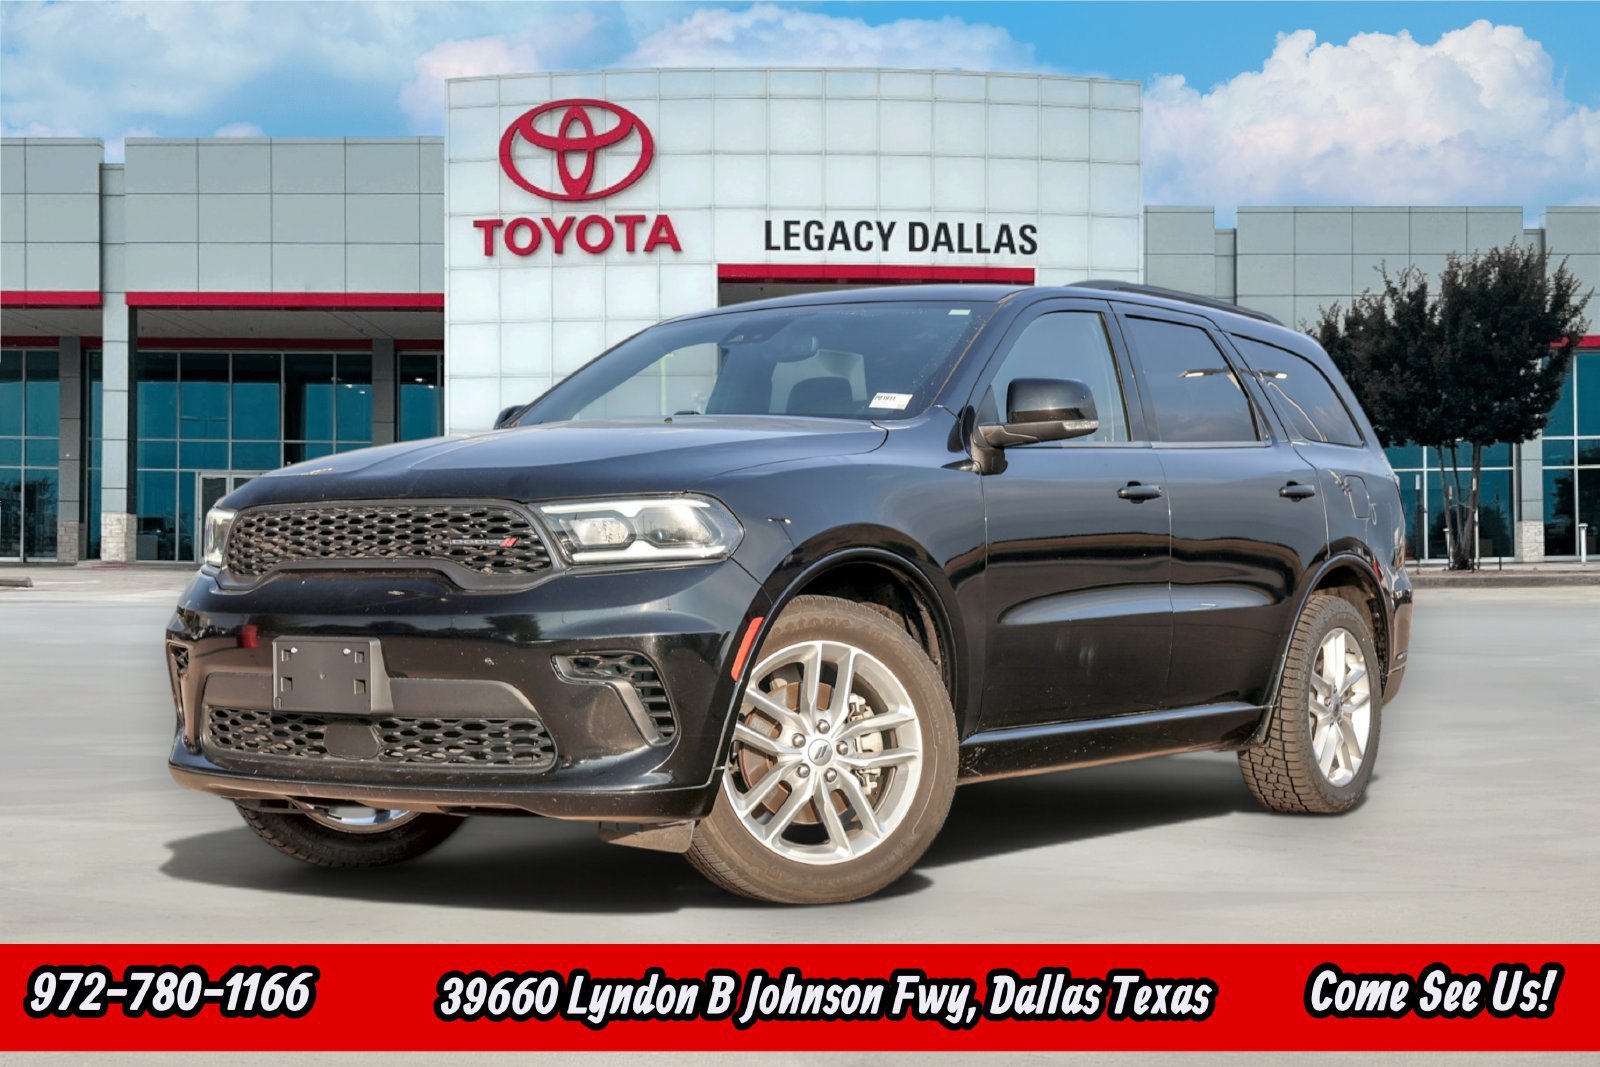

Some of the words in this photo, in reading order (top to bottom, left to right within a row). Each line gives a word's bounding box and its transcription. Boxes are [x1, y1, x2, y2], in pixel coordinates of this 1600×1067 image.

[474, 214, 682, 257] TOYOTA
[765, 220, 896, 252] LEGACY
[908, 221, 1038, 255] DALLAS
